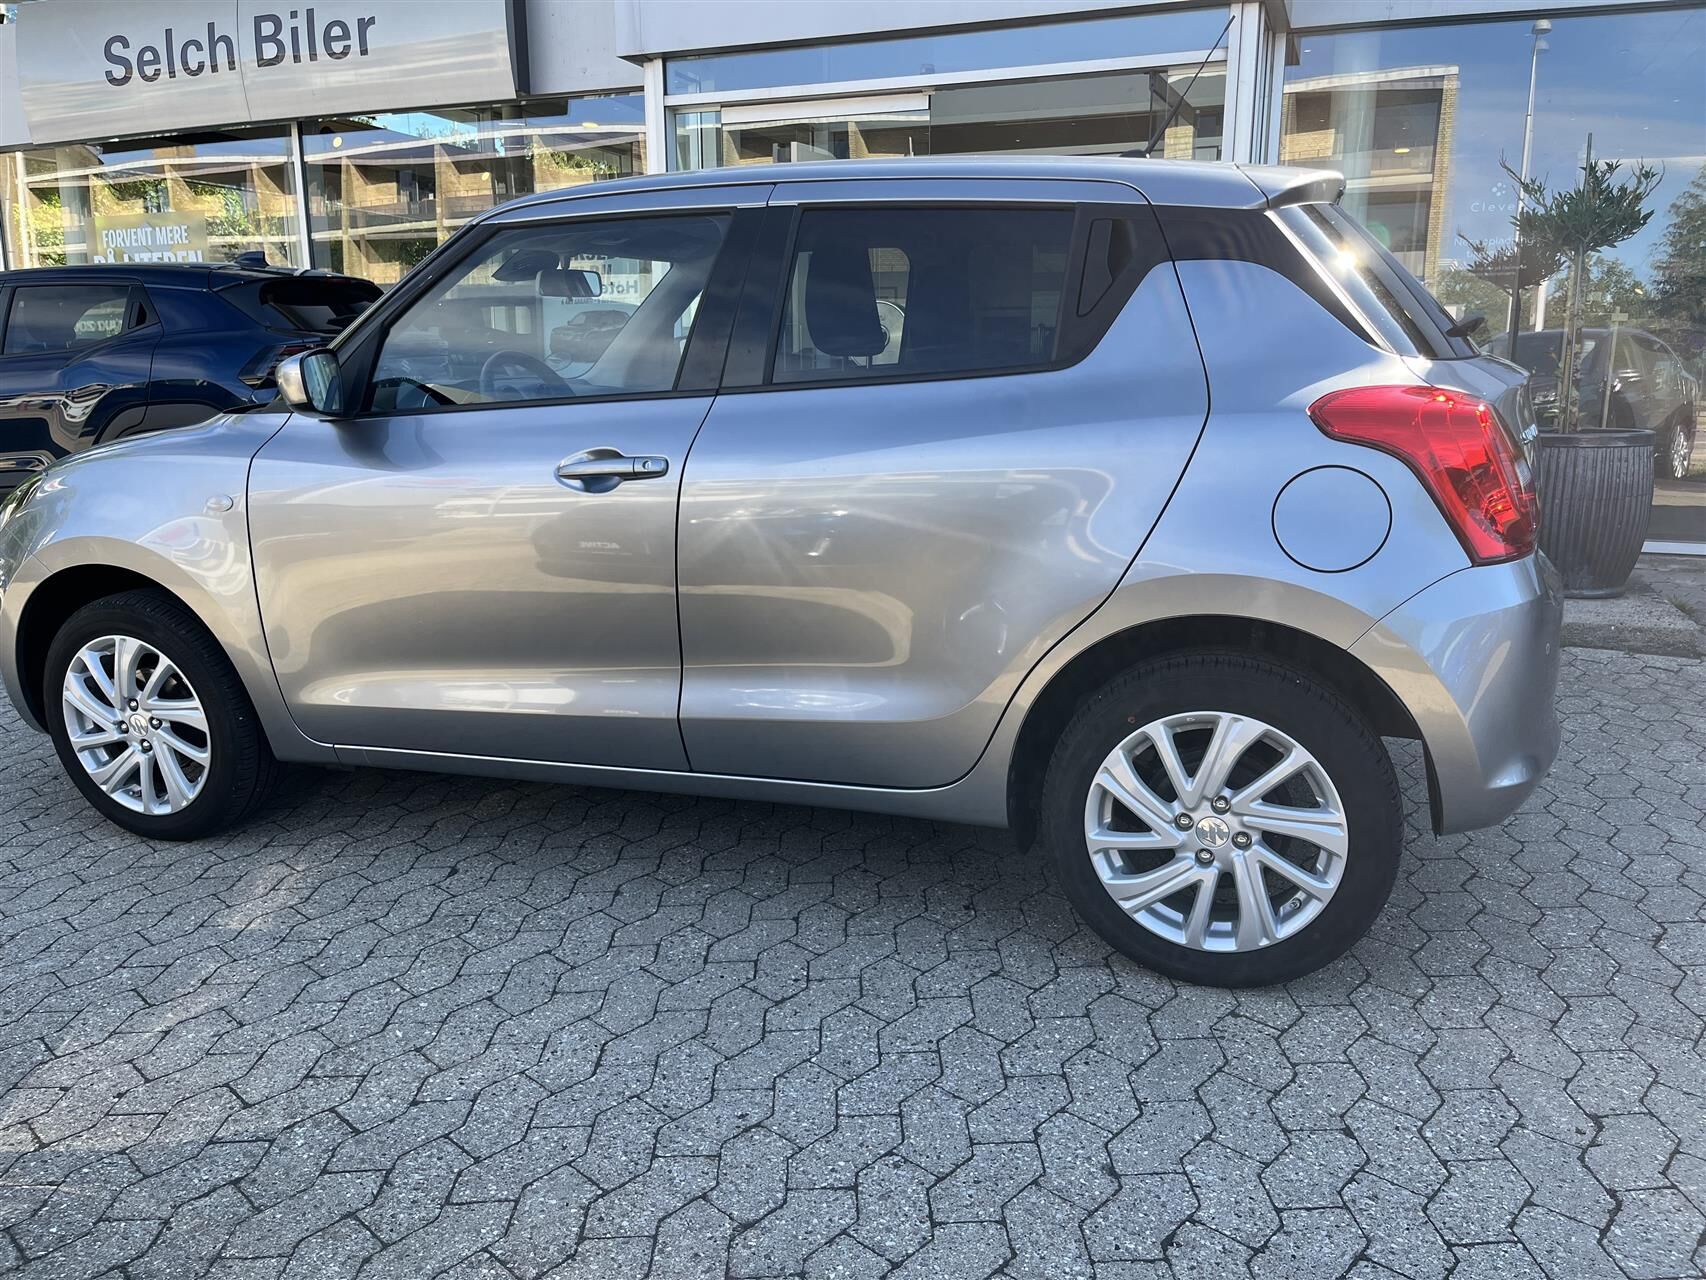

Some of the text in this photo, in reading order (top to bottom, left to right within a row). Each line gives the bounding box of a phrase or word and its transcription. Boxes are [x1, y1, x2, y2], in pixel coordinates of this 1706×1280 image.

[103, 8, 376, 87] Selch Biler
[1470, 202, 1516, 212] Cleve
[102, 224, 190, 248] FORVENT MERE
